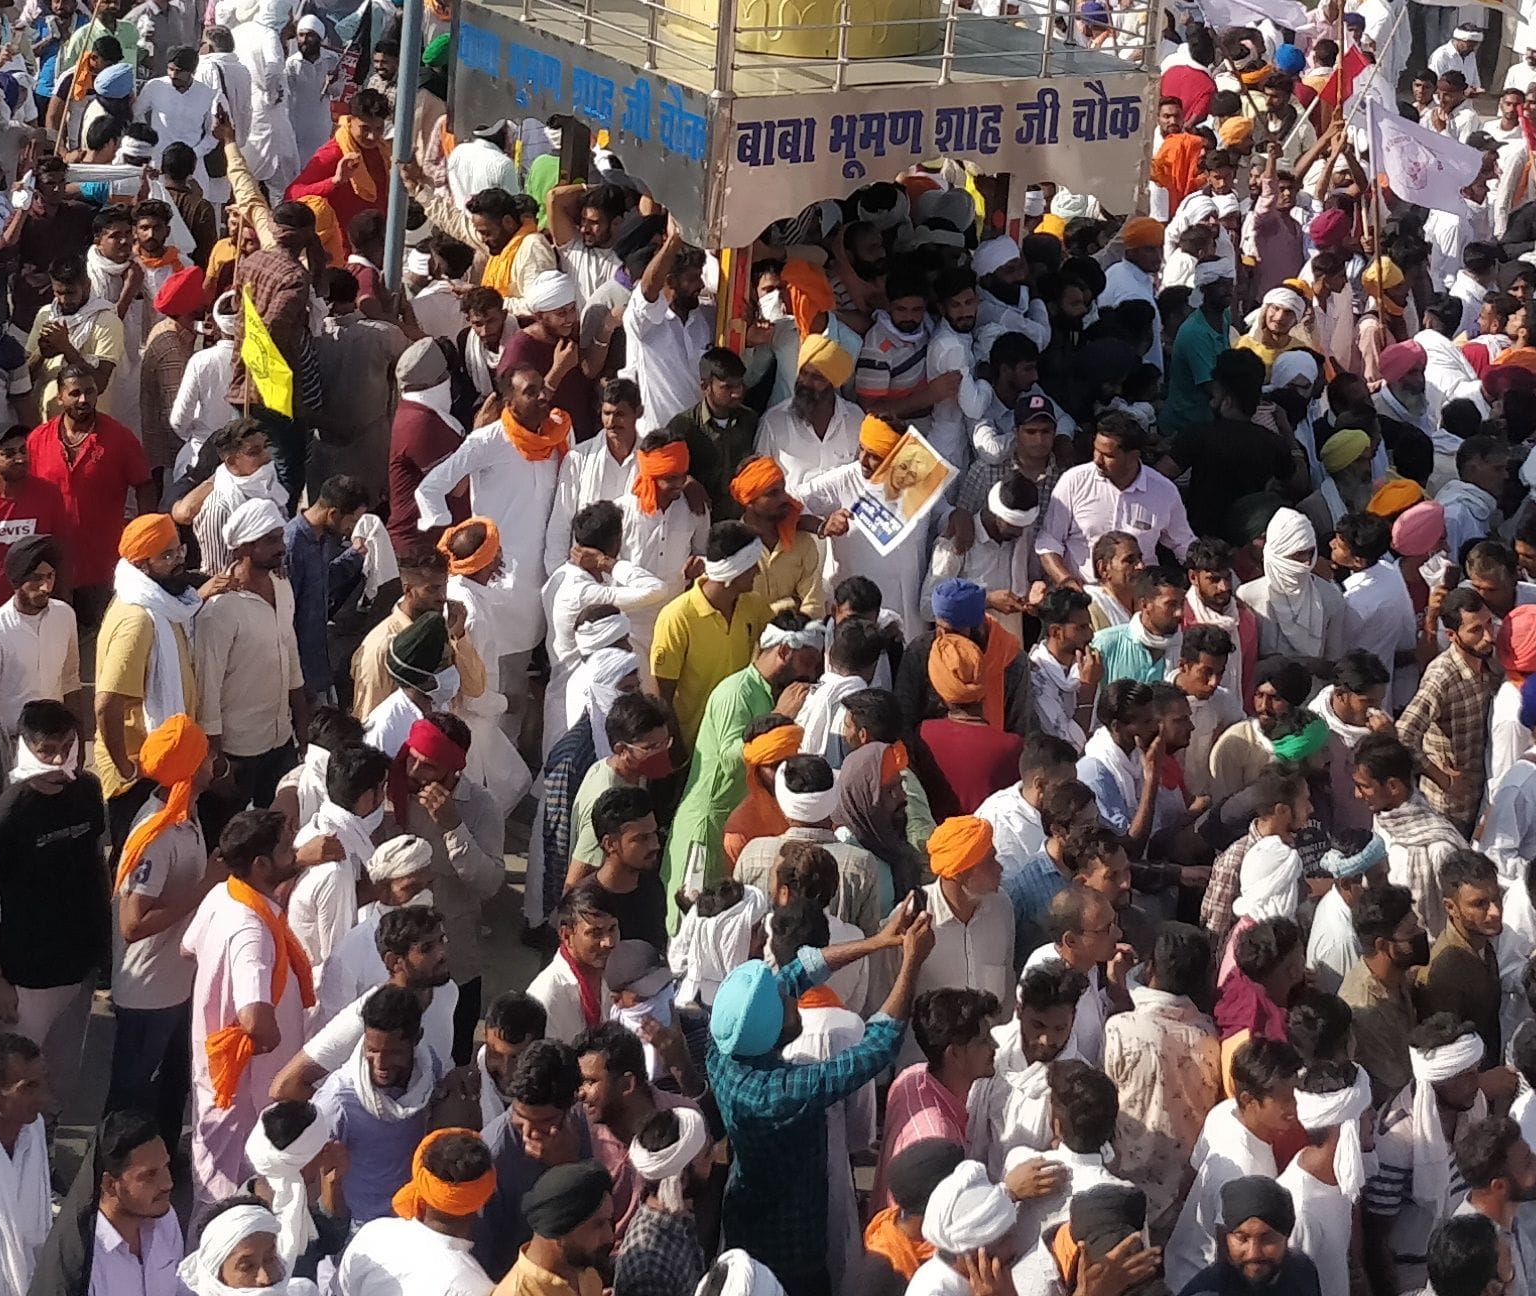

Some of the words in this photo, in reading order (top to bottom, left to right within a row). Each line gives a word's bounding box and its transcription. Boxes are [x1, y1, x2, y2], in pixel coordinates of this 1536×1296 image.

[737, 116, 816, 168] बाबा
[830, 110, 923, 180] भूमण
[934, 104, 1003, 157] शाह
[1015, 87, 1061, 147] जी
[1072, 79, 1143, 142] चौक
